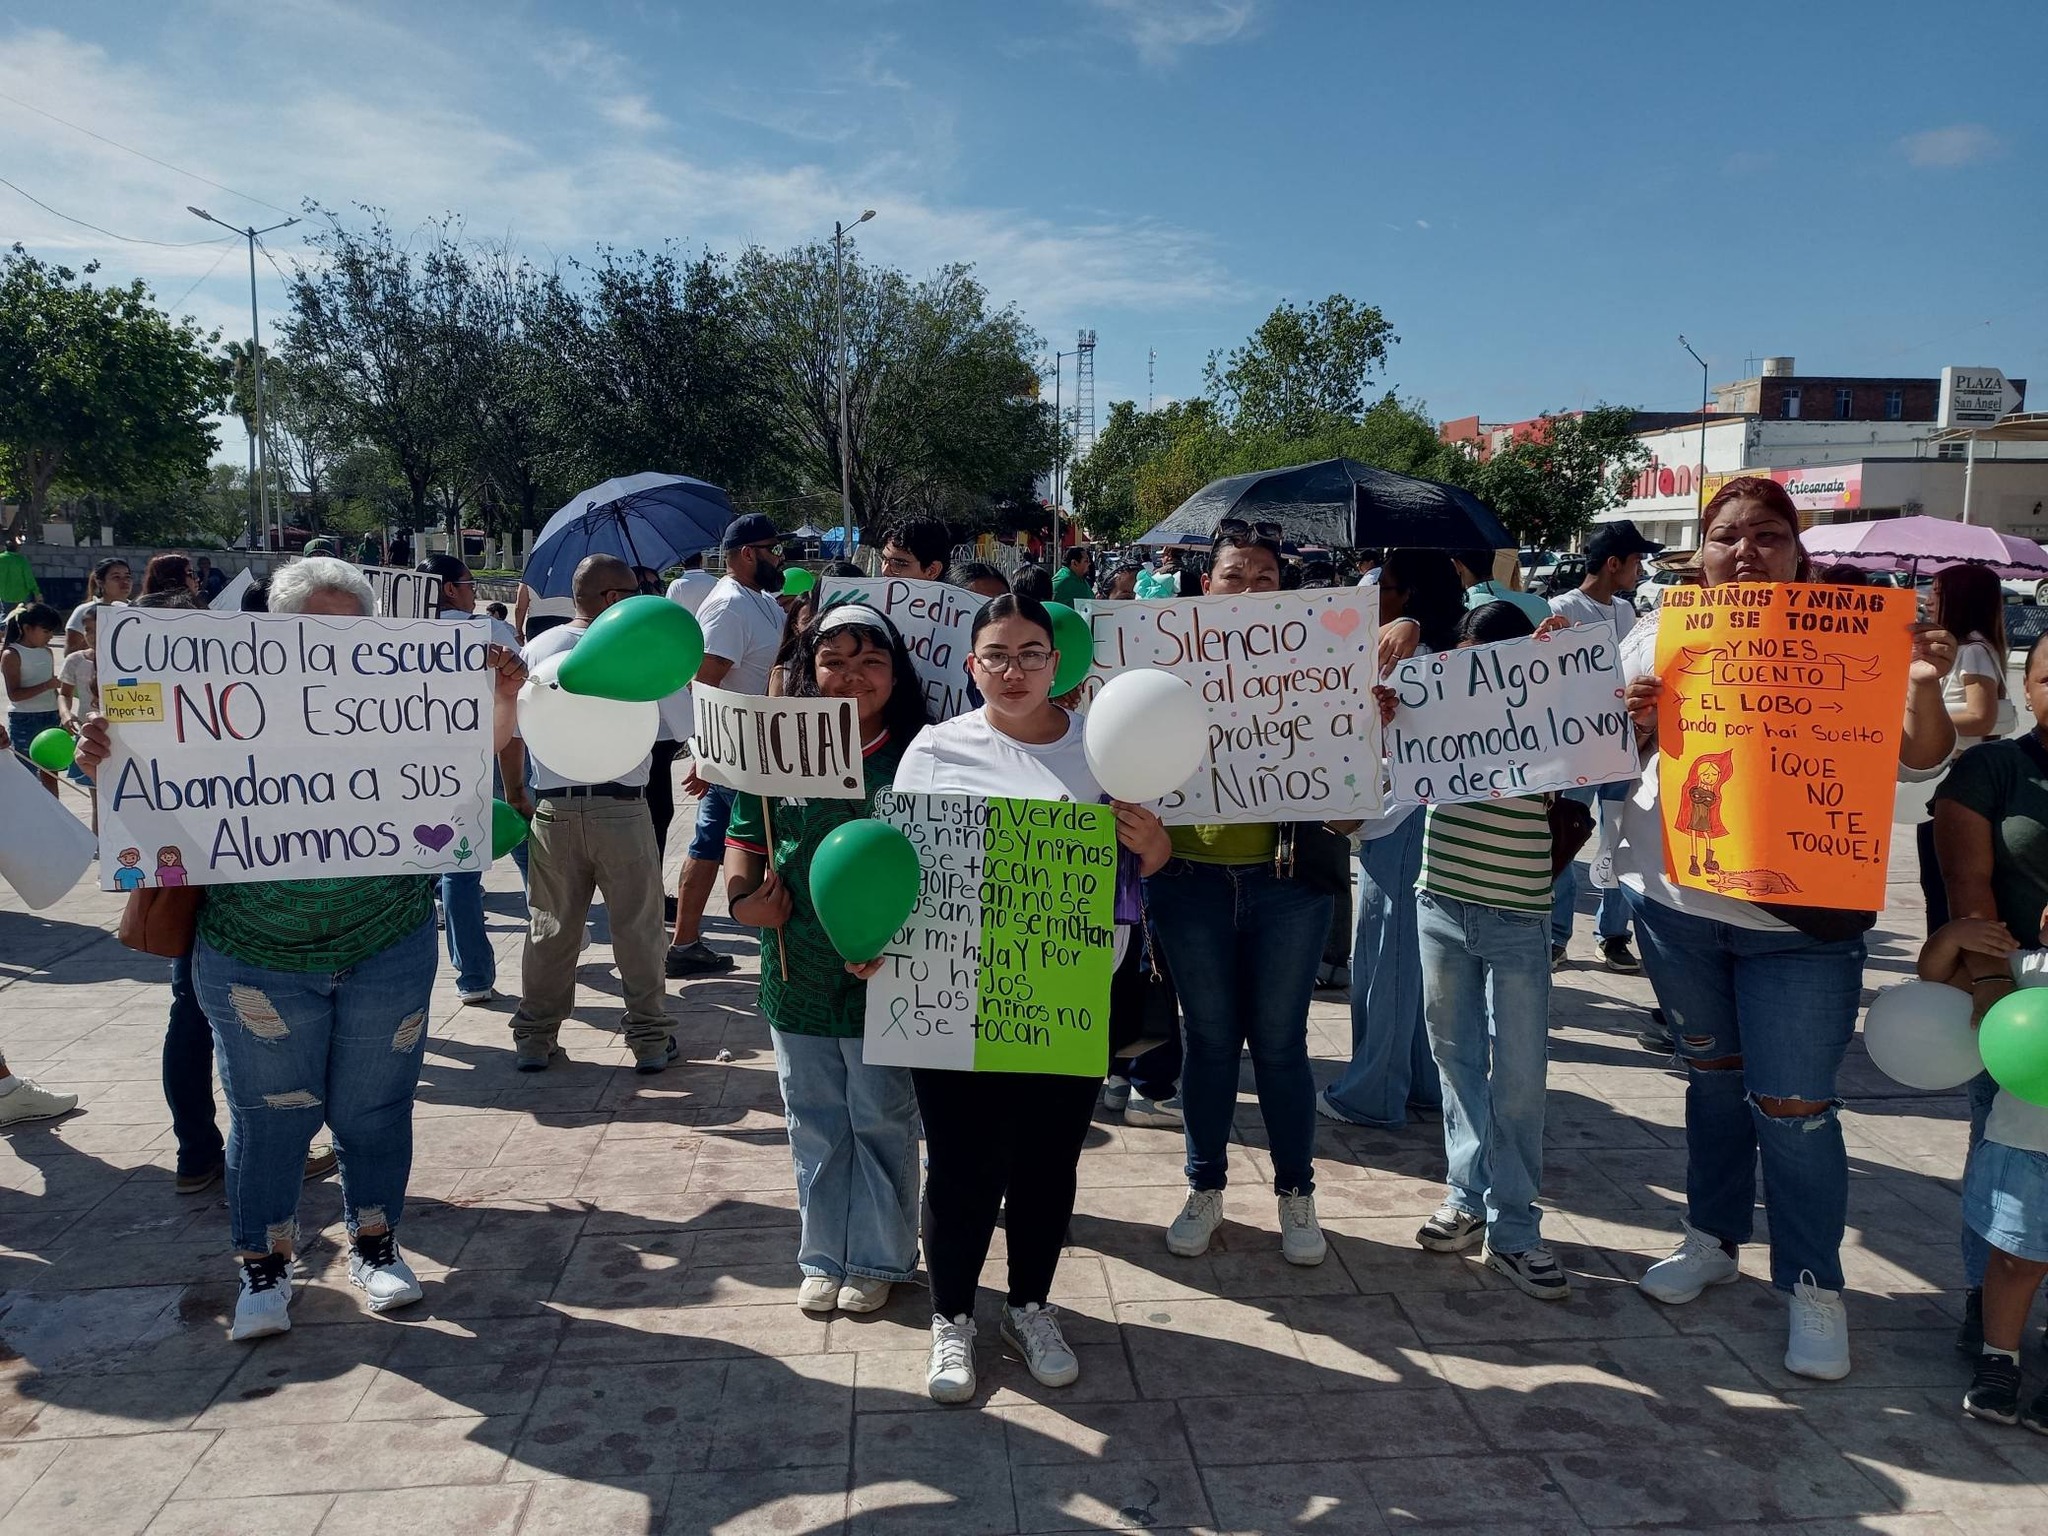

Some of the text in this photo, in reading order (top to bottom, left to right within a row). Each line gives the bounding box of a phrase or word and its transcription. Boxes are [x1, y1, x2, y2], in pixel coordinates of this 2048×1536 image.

[1956, 375, 2002, 389] PLAZA
[1954, 396, 1972, 408] San
[363, 569, 442, 619] TICIA
[885, 581, 971, 628] Pedir
[1663, 584, 1885, 614] LOS NIÑOS Y NIÑAS
[1091, 607, 1307, 669] El Silencio
[1685, 611, 1869, 634] NO SE TOCAN
[110, 617, 490, 676] Cuando la escuela
[902, 627, 952, 669] uda
[1726, 638, 1818, 660] Y NO ES
[1202, 663, 1233, 703] al
[1243, 663, 1358, 715] agresor,
[1400, 644, 1613, 708] Si Algo me
[1722, 663, 1823, 685] CUENTO
[105, 688, 152, 702] Tu Voz
[105, 704, 155, 718] Importa
[1701, 693, 1812, 715] EL LOBO
[174, 681, 480, 743] NO Escucha
[1331, 713, 1353, 737] a
[699, 698, 857, 790] JUSTICIA!
[1547, 707, 1584, 746] lo
[1585, 710, 1629, 752] voy
[1678, 714, 1717, 733] anda
[1725, 721, 1754, 738] por
[1812, 724, 1884, 743] Suelto
[1771, 746, 1837, 778] ¡QUE
[113, 755, 336, 812] Abandona
[349, 767, 380, 802] a
[1211, 764, 1330, 813] Niños
[1414, 760, 1529, 798] a decir
[1807, 782, 1843, 806] NO
[1006, 798, 1097, 830] Verde
[1826, 811, 1866, 835] TE
[209, 817, 400, 871] Alumnos
[1037, 837, 1113, 867] niñas
[1787, 832, 1880, 863] TOQUE!
[1063, 871, 1097, 894] no
[980, 905, 1007, 929] no
[1047, 915, 1115, 948] matan
[892, 927, 915, 945] or
[926, 929, 957, 952] mi
[963, 931, 1011, 969] hija
[950, 959, 1033, 1001] hijos
[915, 984, 969, 1011] Los
[1057, 1006, 1091, 1031] no
[970, 1014, 1050, 1046] tocan
